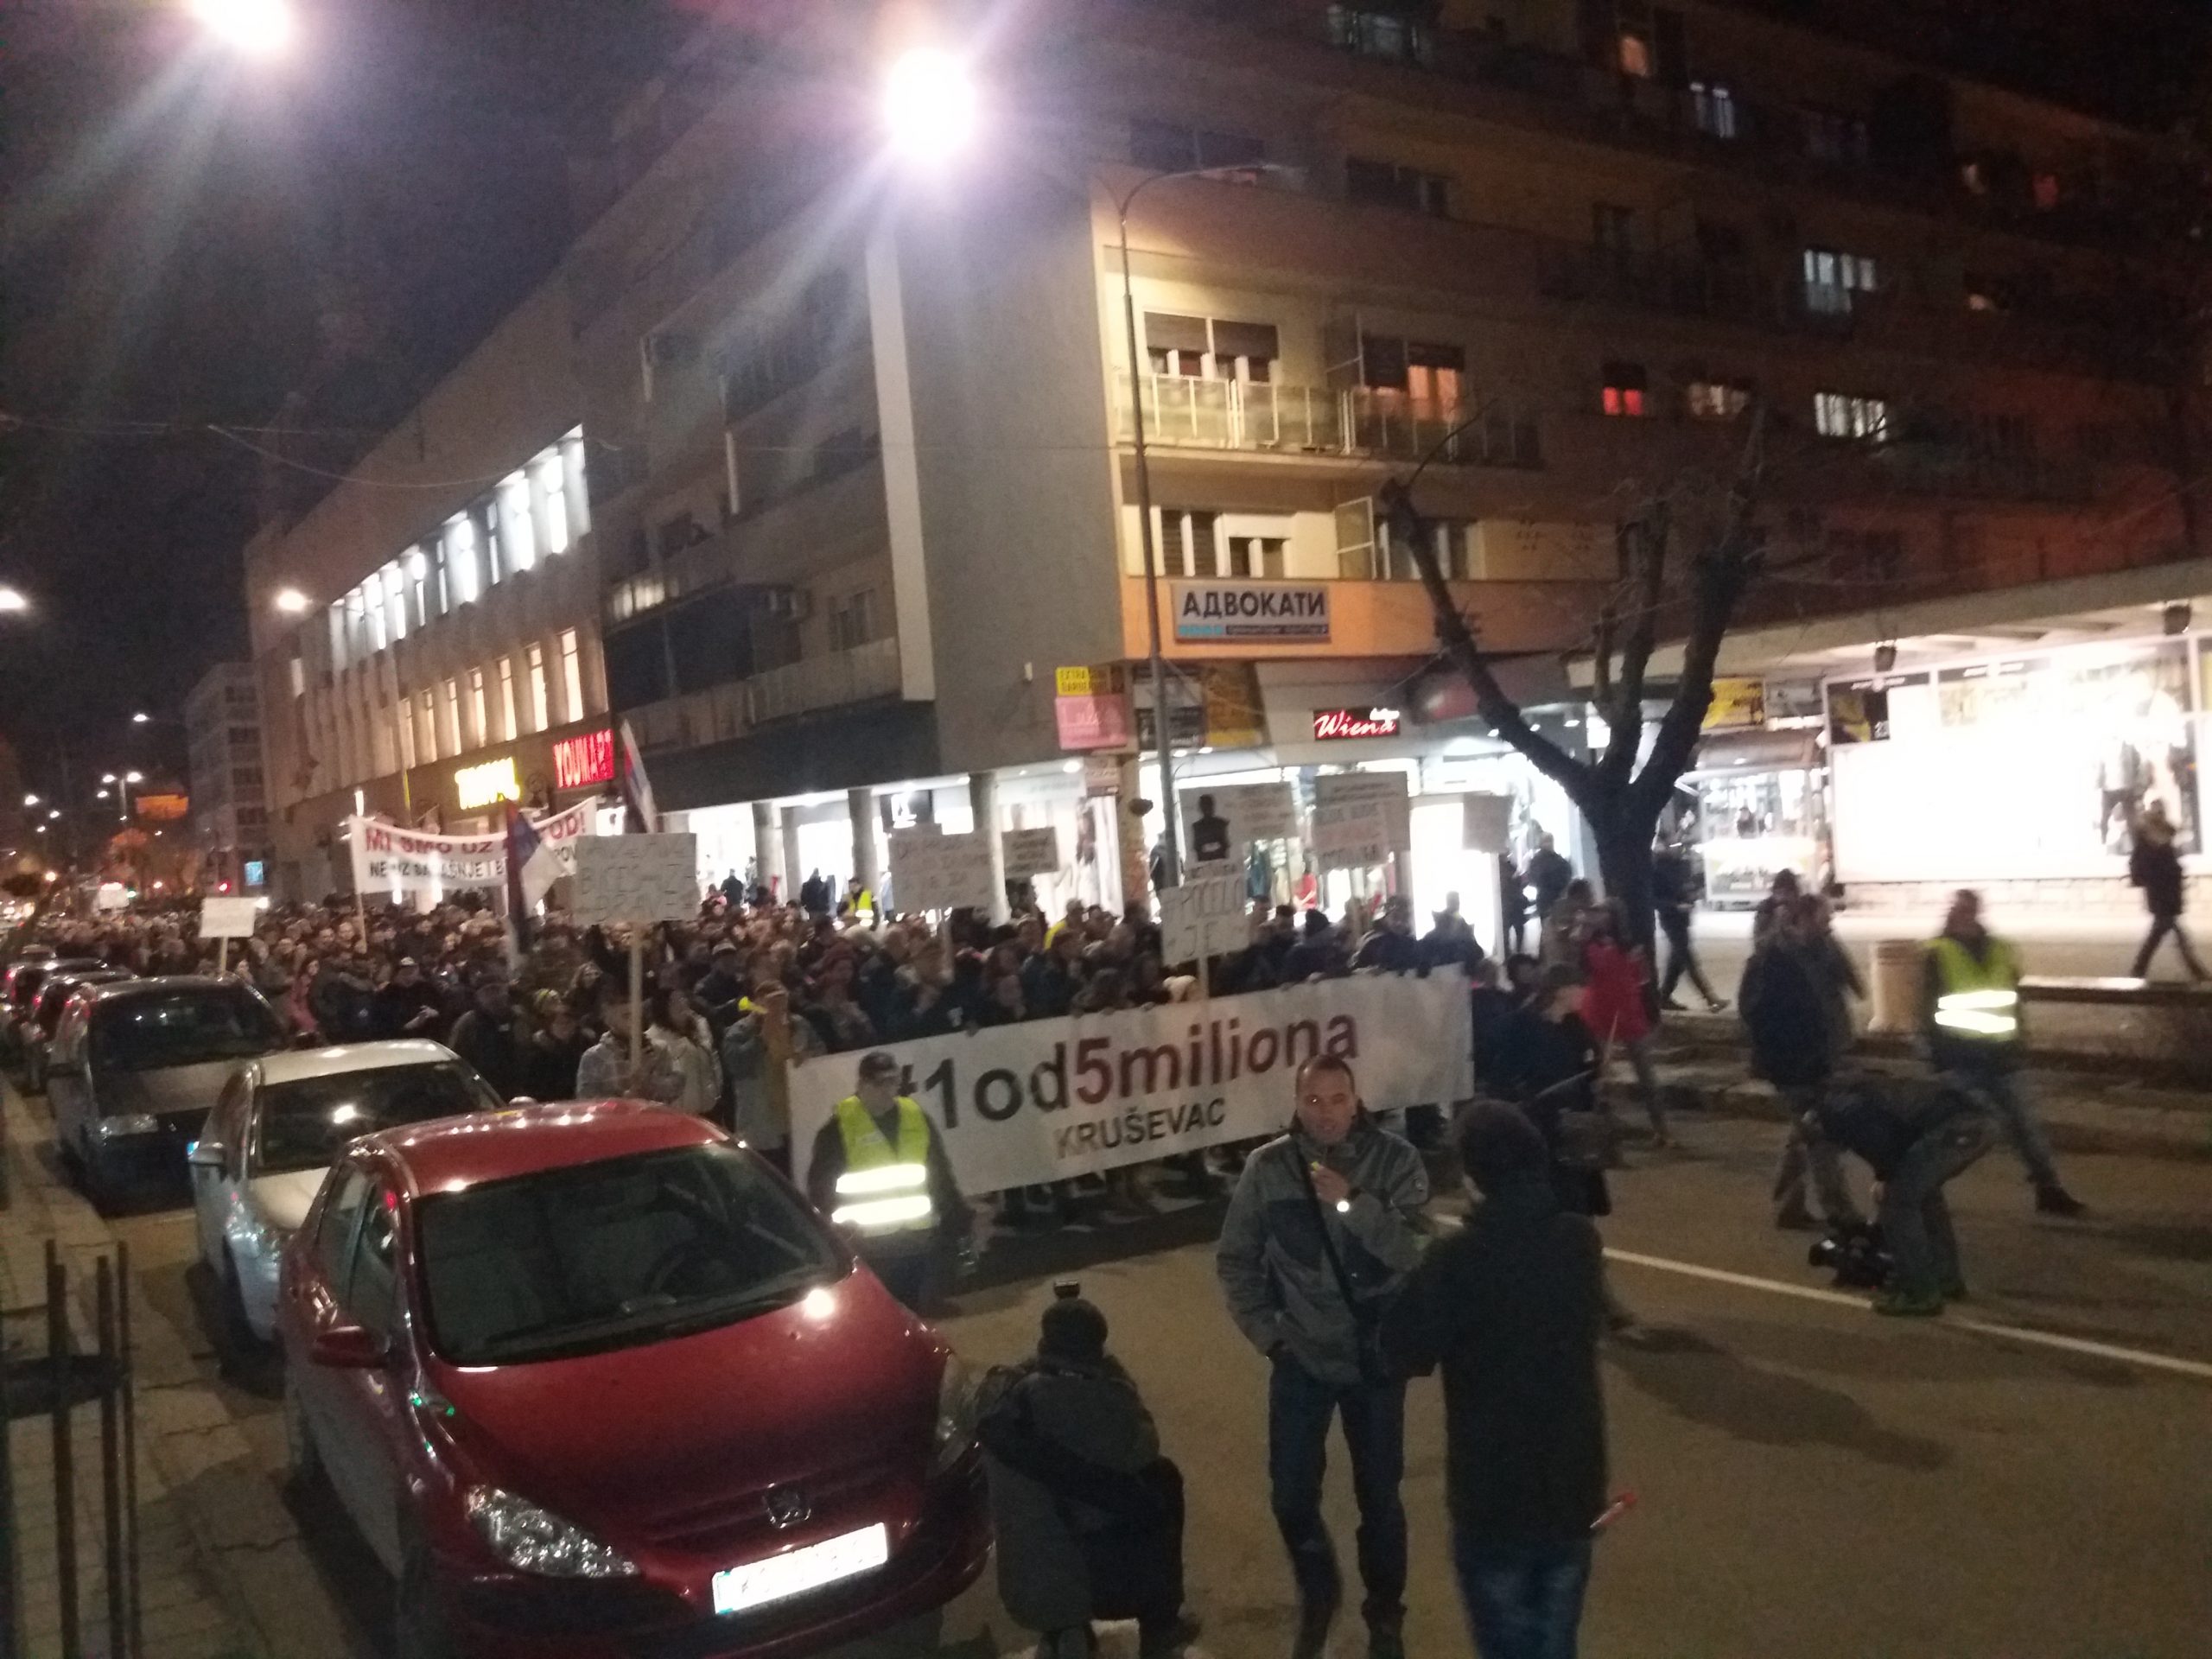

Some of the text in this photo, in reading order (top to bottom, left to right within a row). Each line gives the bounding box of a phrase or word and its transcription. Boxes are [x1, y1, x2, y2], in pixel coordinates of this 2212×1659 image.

[1183, 590, 1325, 619] АДВОКАТИ
[400, 836, 452, 855] SMO
[461, 841, 493, 854] UZ
[1054, 1097, 1225, 1159] KRUŠEVAC
